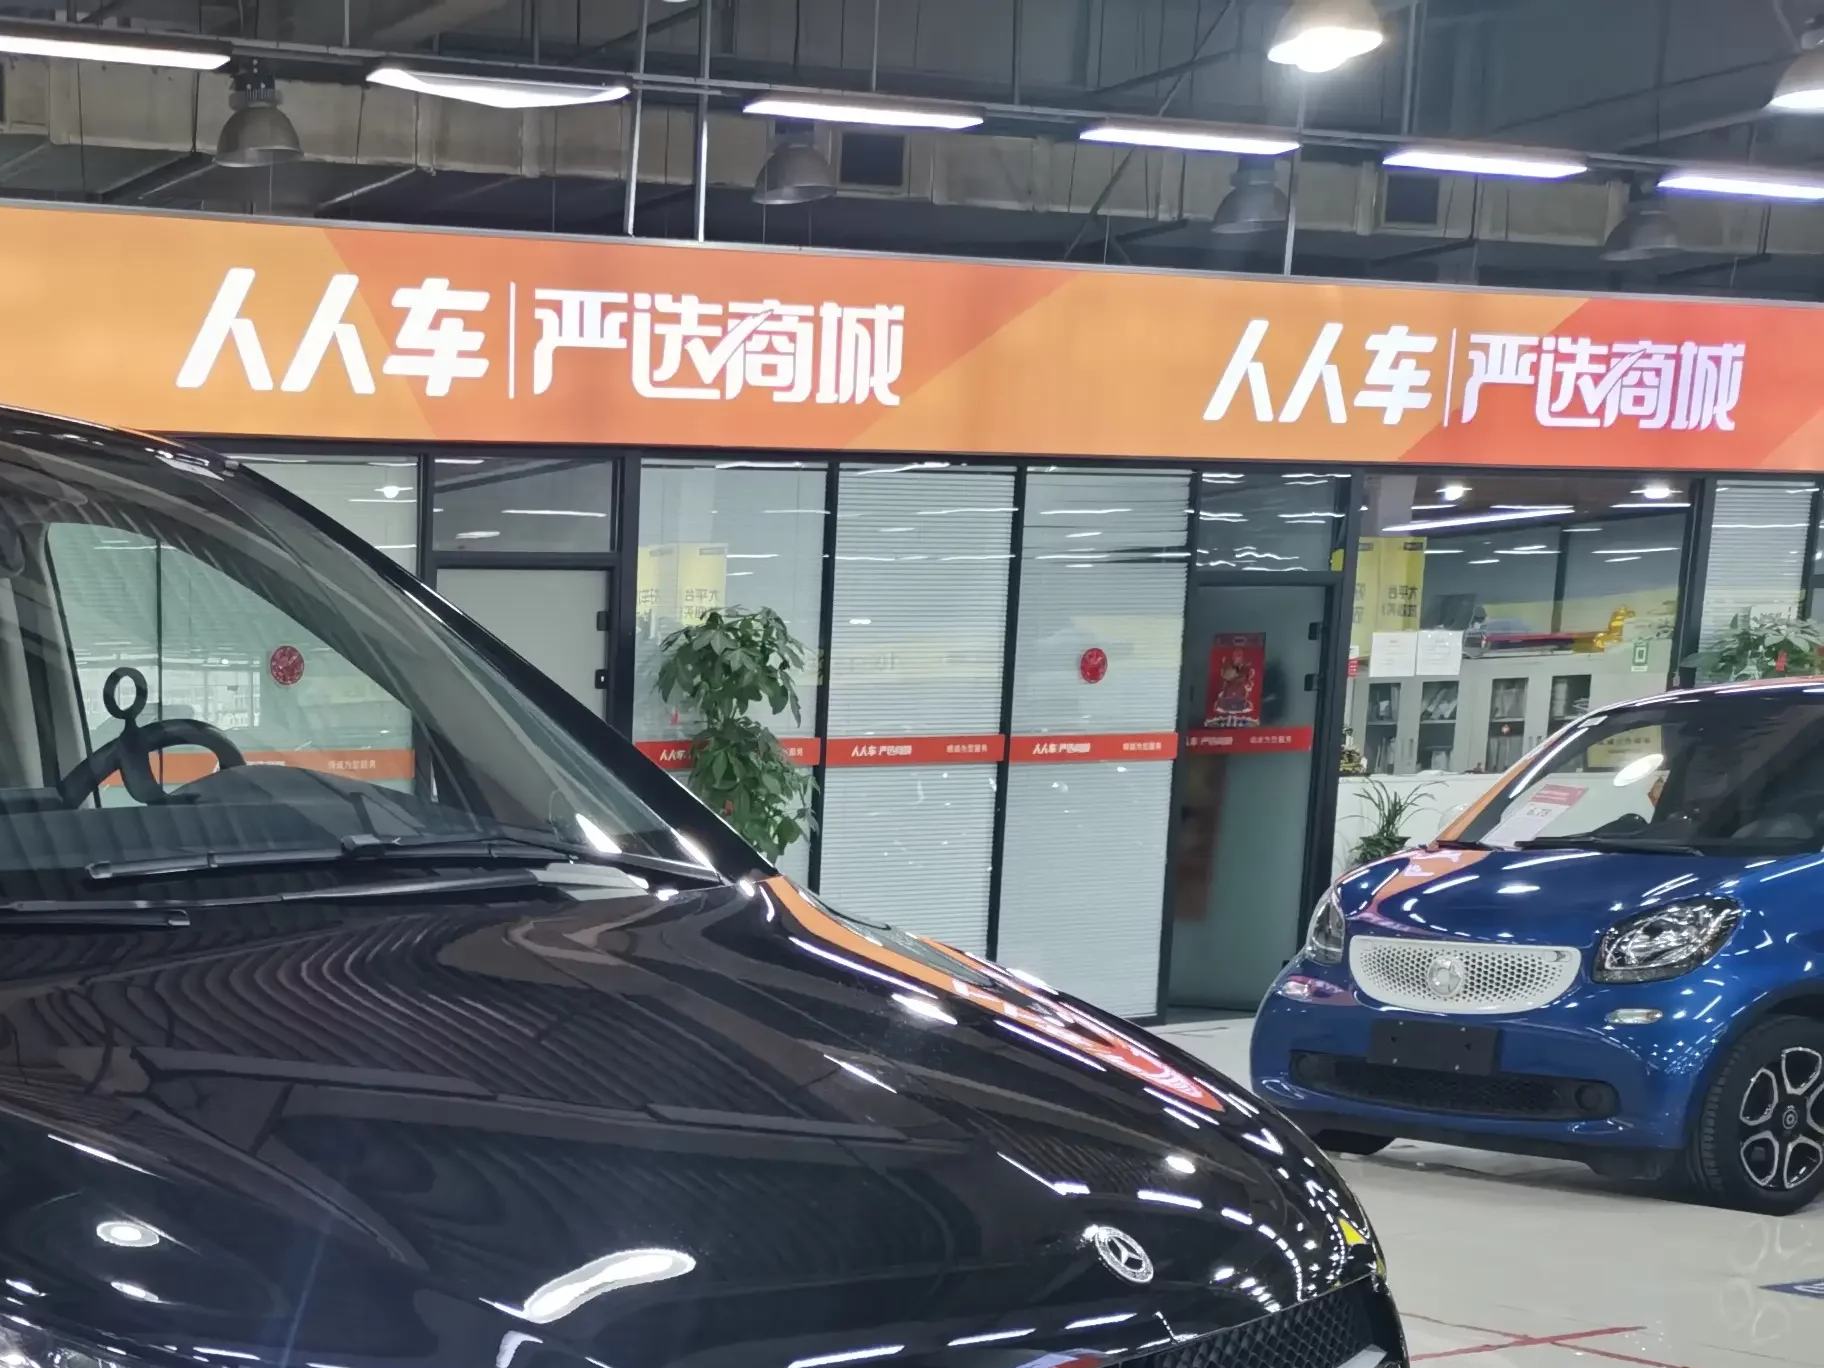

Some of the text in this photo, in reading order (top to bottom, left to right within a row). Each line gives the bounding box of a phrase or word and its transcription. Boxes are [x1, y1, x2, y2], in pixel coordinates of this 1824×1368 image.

[176, 267, 906, 406] 人人车 严选商城
[1203, 319, 1746, 431] 人人车 严选商城
